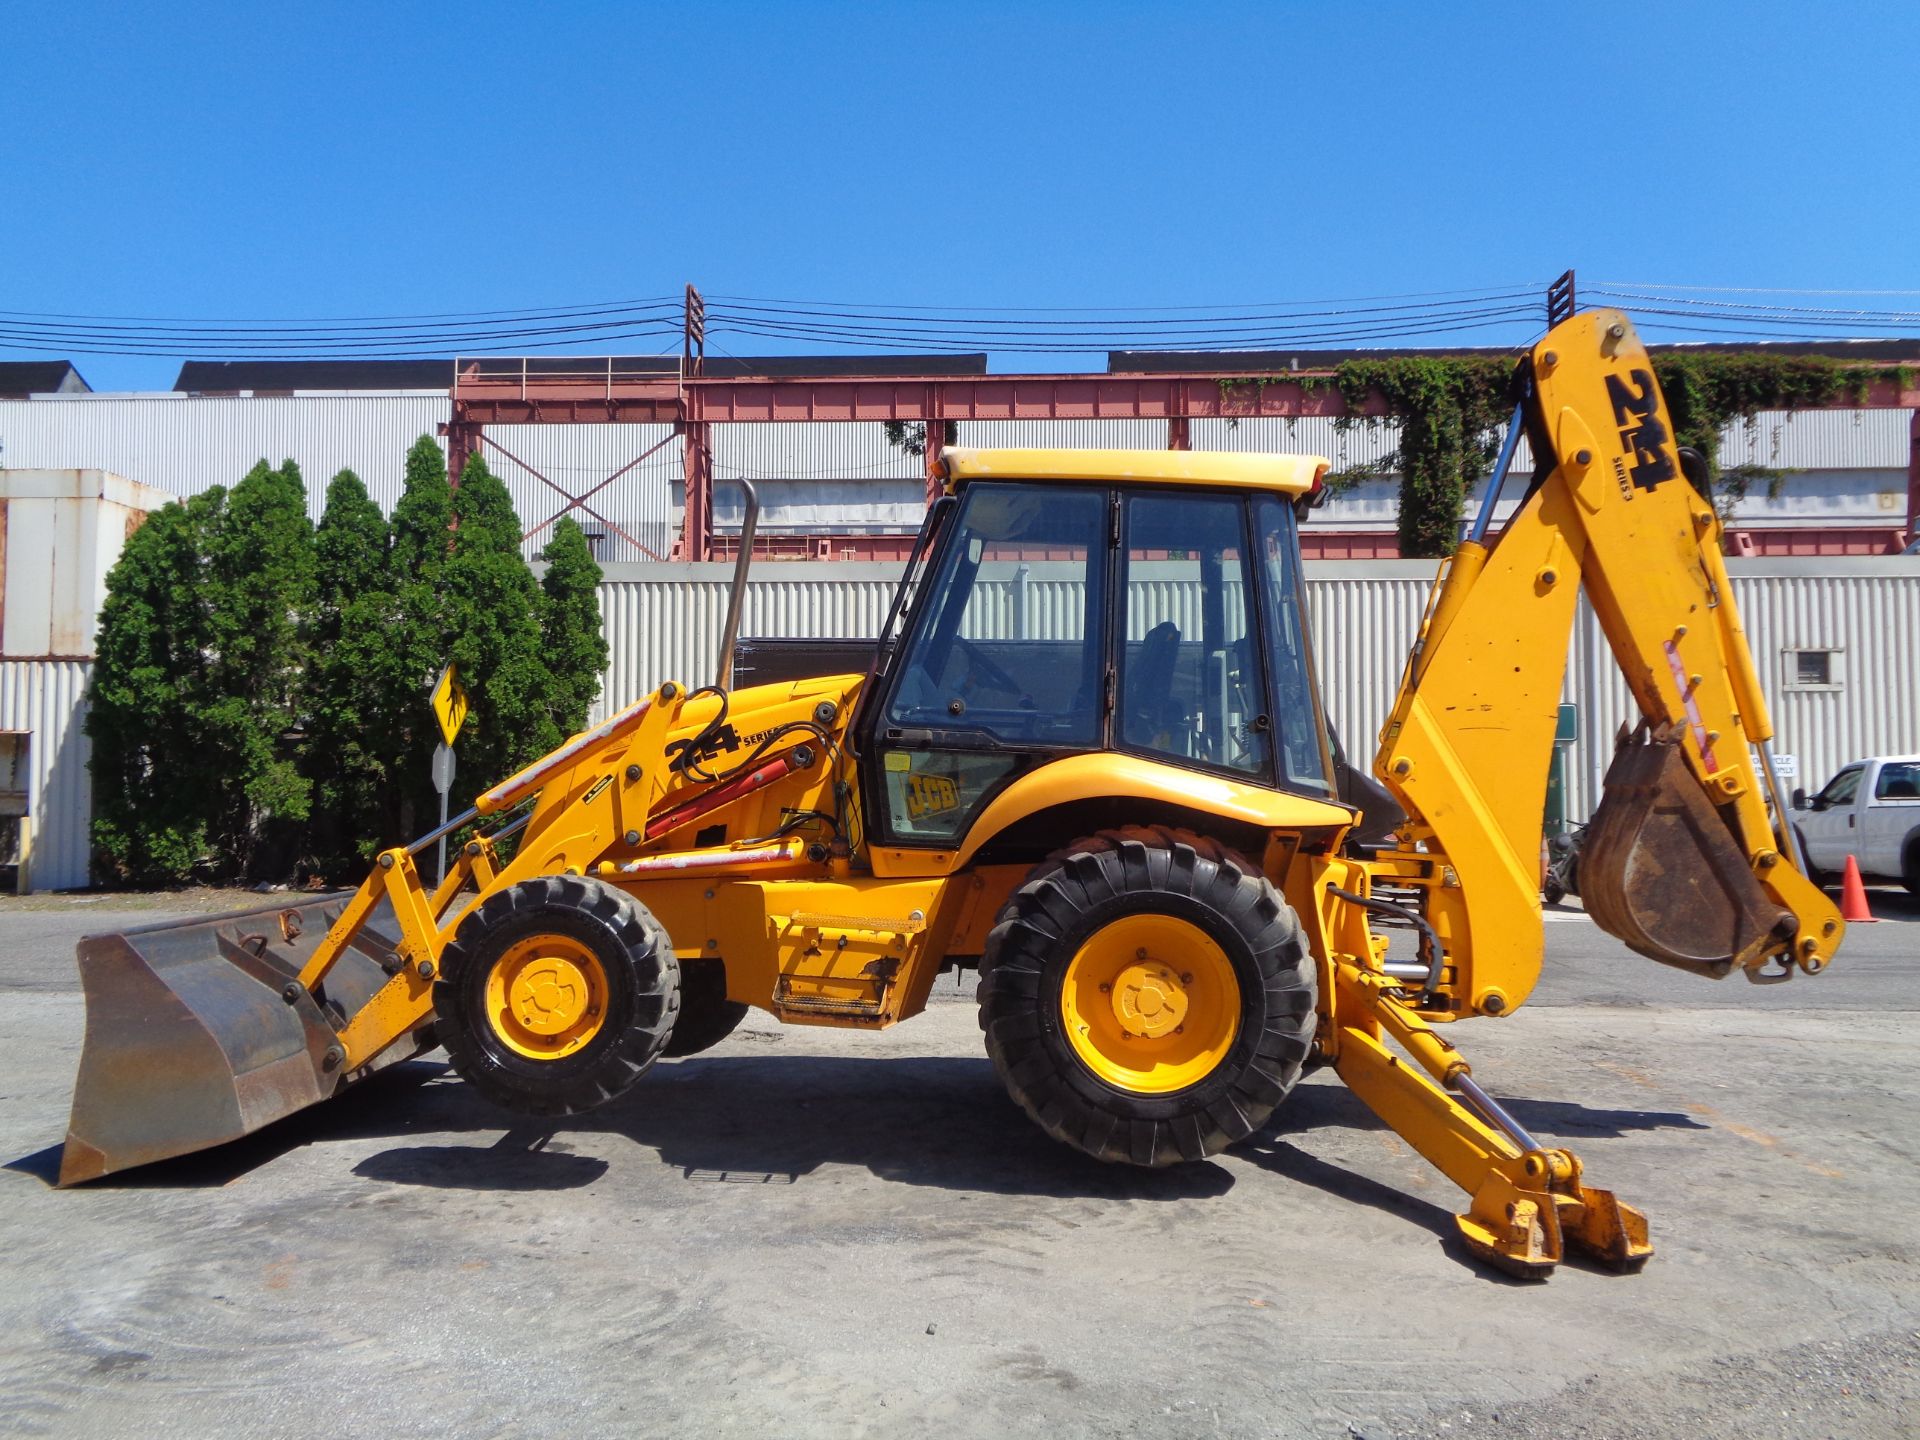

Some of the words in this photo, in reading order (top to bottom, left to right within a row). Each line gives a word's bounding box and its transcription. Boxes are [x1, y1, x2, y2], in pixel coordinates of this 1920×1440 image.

[1604, 369, 1679, 493] 214
[1612, 456, 1630, 491] SERIES
[1622, 493, 1633, 501] 3
[908, 774, 955, 815] JCB
